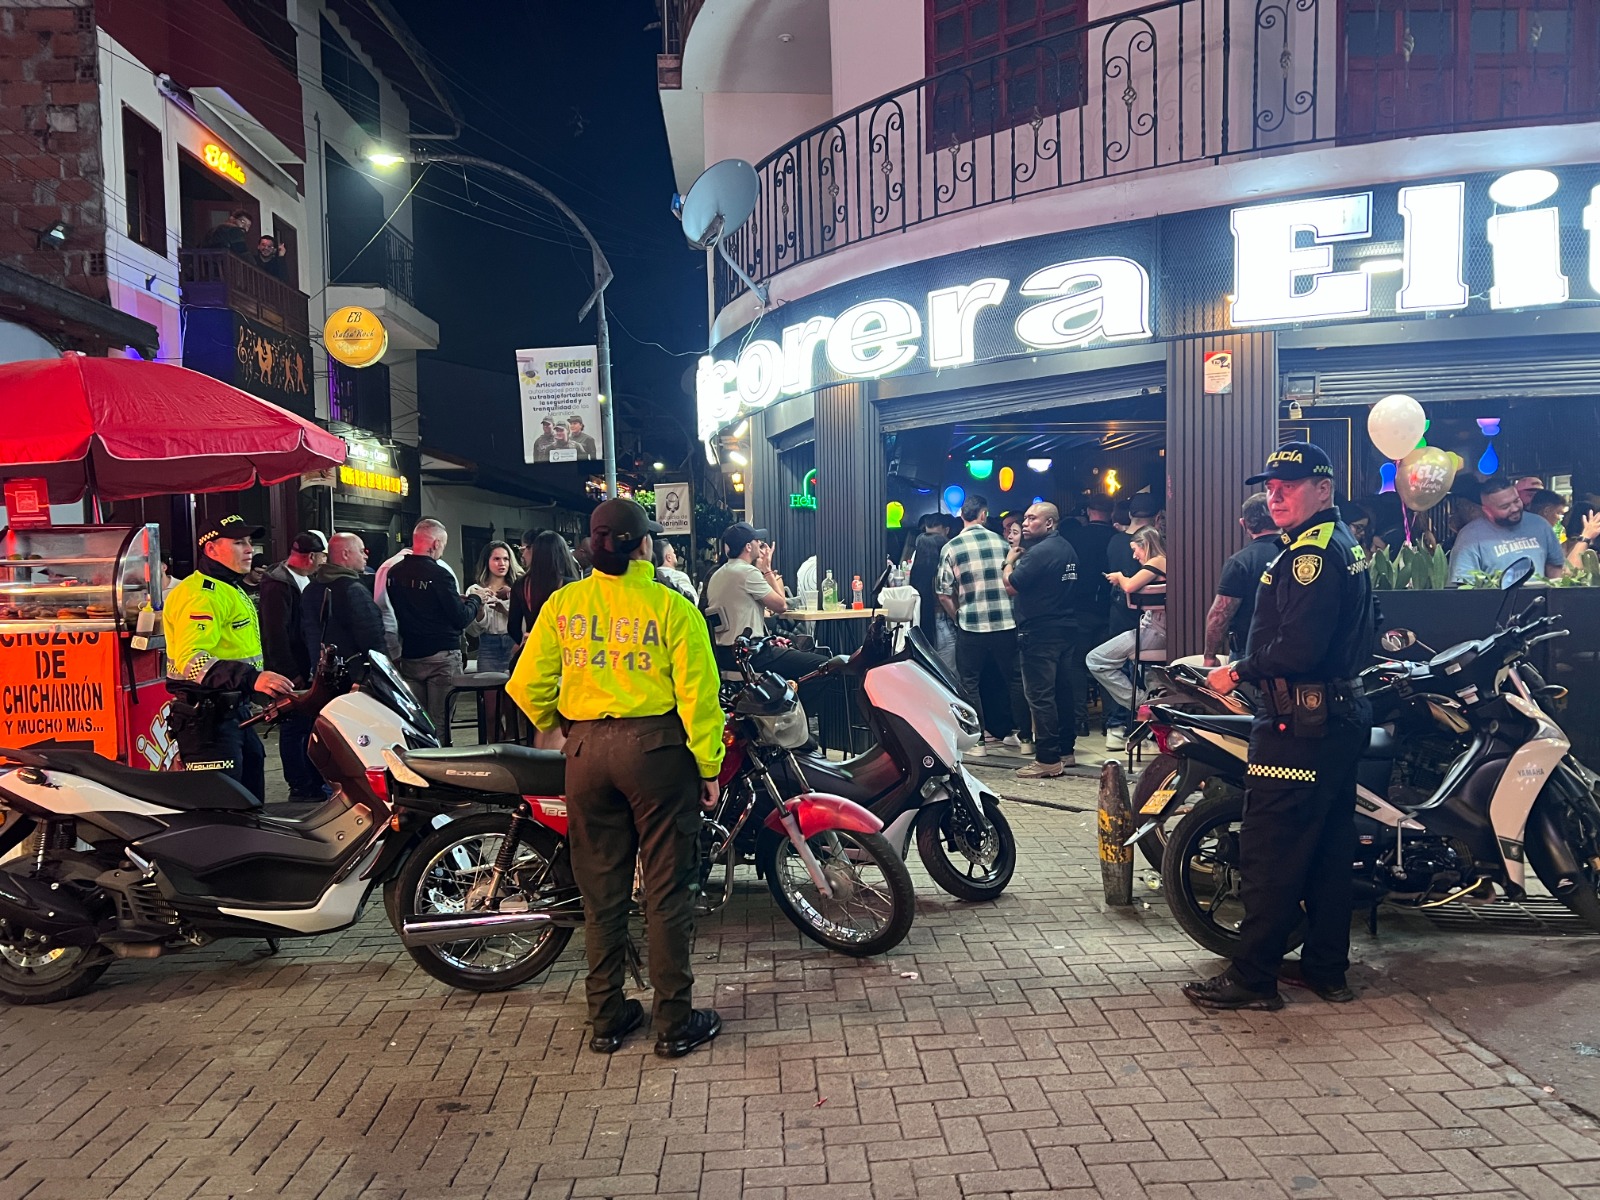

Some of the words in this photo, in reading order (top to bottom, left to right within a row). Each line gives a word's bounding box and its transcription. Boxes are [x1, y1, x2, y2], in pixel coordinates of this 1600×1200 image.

[546, 367, 592, 376] fortalecida
[548, 359, 592, 370] Seguridad
[537, 393, 560, 401] trabajo
[546, 398, 577, 407] seguridad
[533, 404, 572, 412] tranquilidad
[1493, 543, 1510, 557] LOS
[1509, 537, 1540, 552] ANGELES
[557, 614, 659, 646] POLICIA
[36, 650, 66, 679] DE
[563, 646, 651, 671] 004713
[3, 675, 103, 714] CHICHARRÓN
[5, 720, 13, 735] Y
[18, 718, 62, 734] MUCHO
[1517, 768, 1545, 777] YAMAHA
